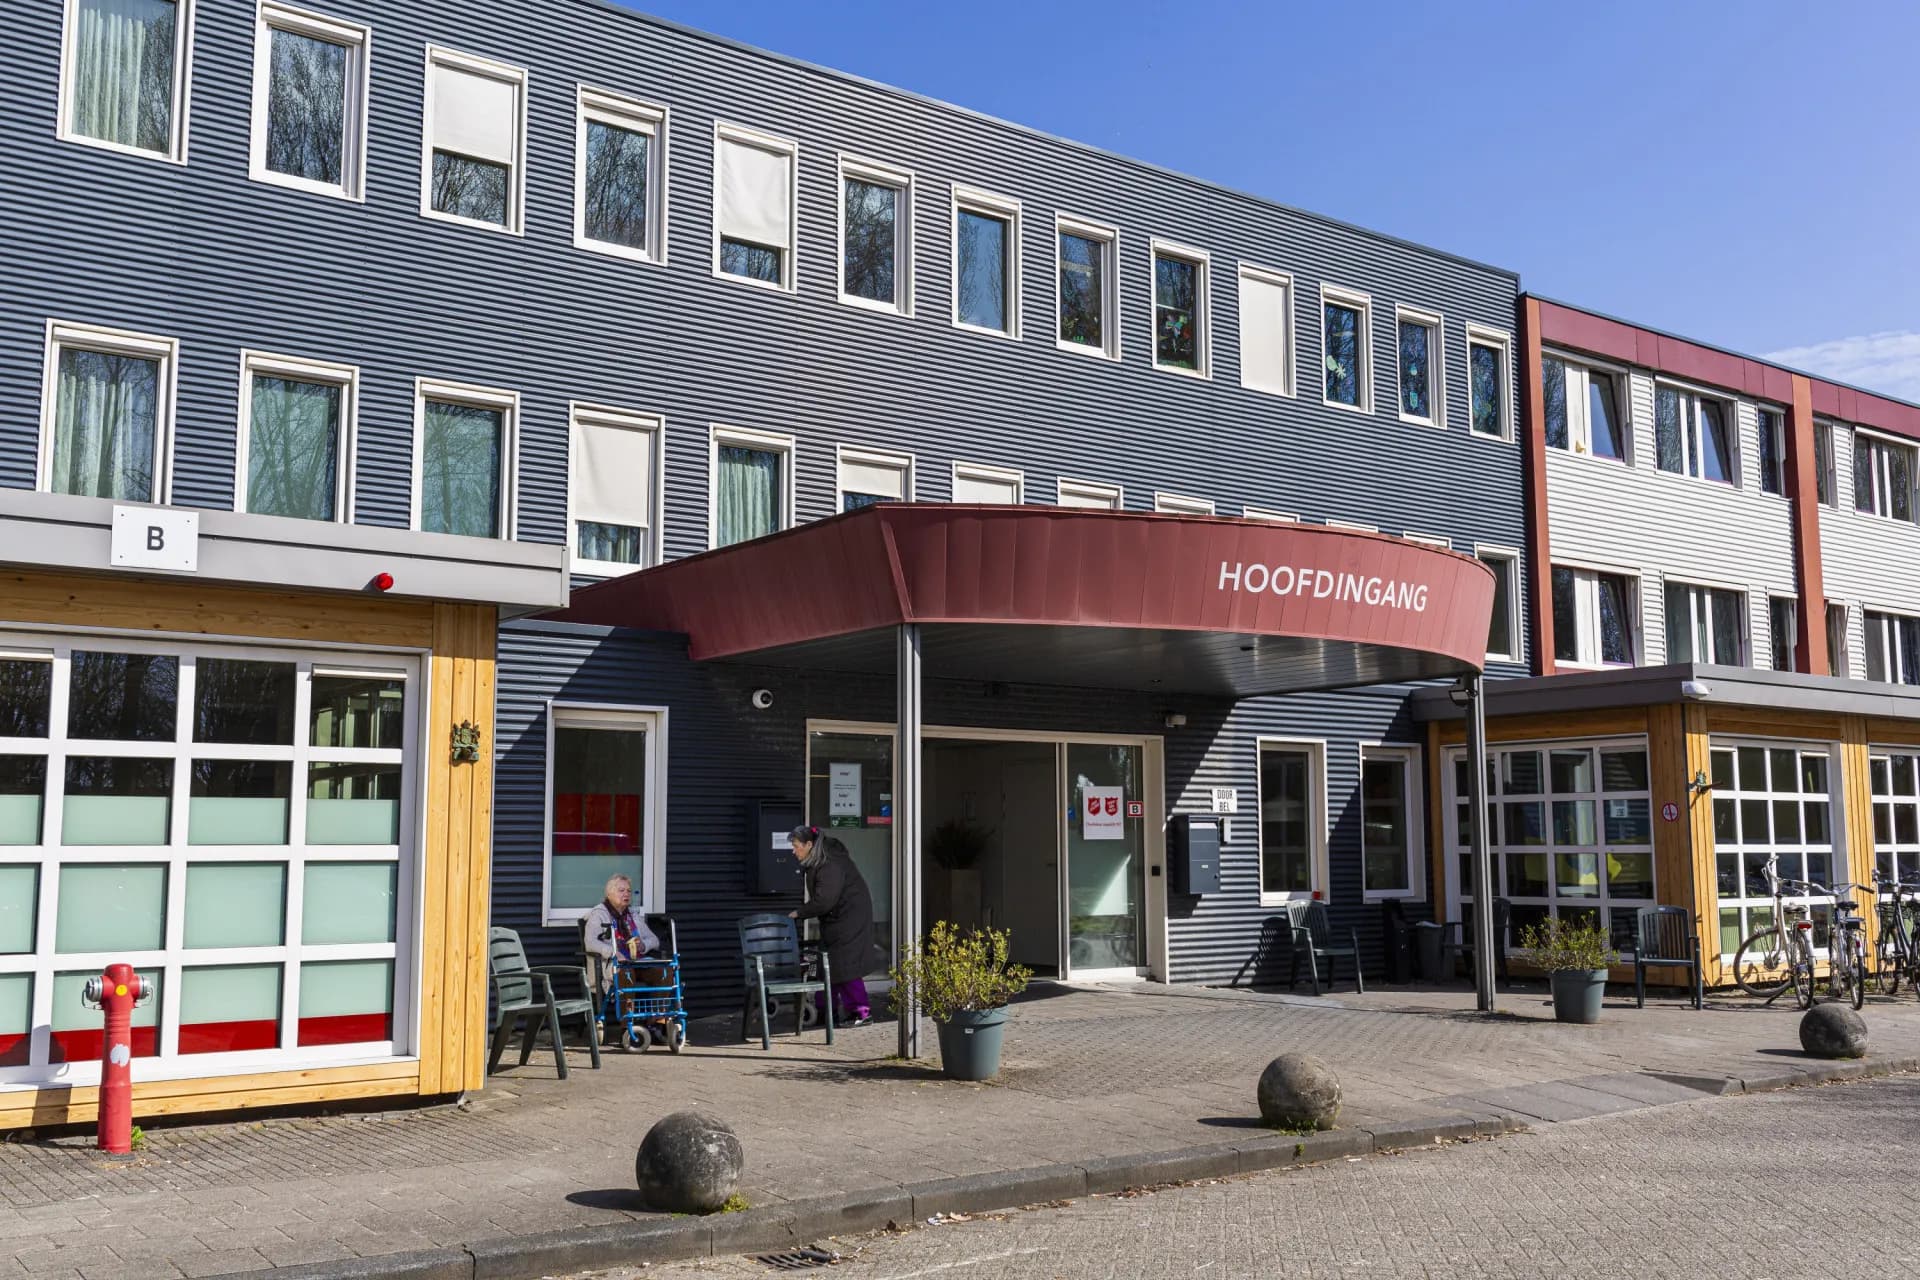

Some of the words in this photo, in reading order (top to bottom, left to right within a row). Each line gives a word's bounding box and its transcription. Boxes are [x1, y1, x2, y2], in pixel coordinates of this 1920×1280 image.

[146, 525, 165, 551] B
[1218, 561, 1429, 612] HOOFDINGANG
[1131, 804, 1139, 814] B
